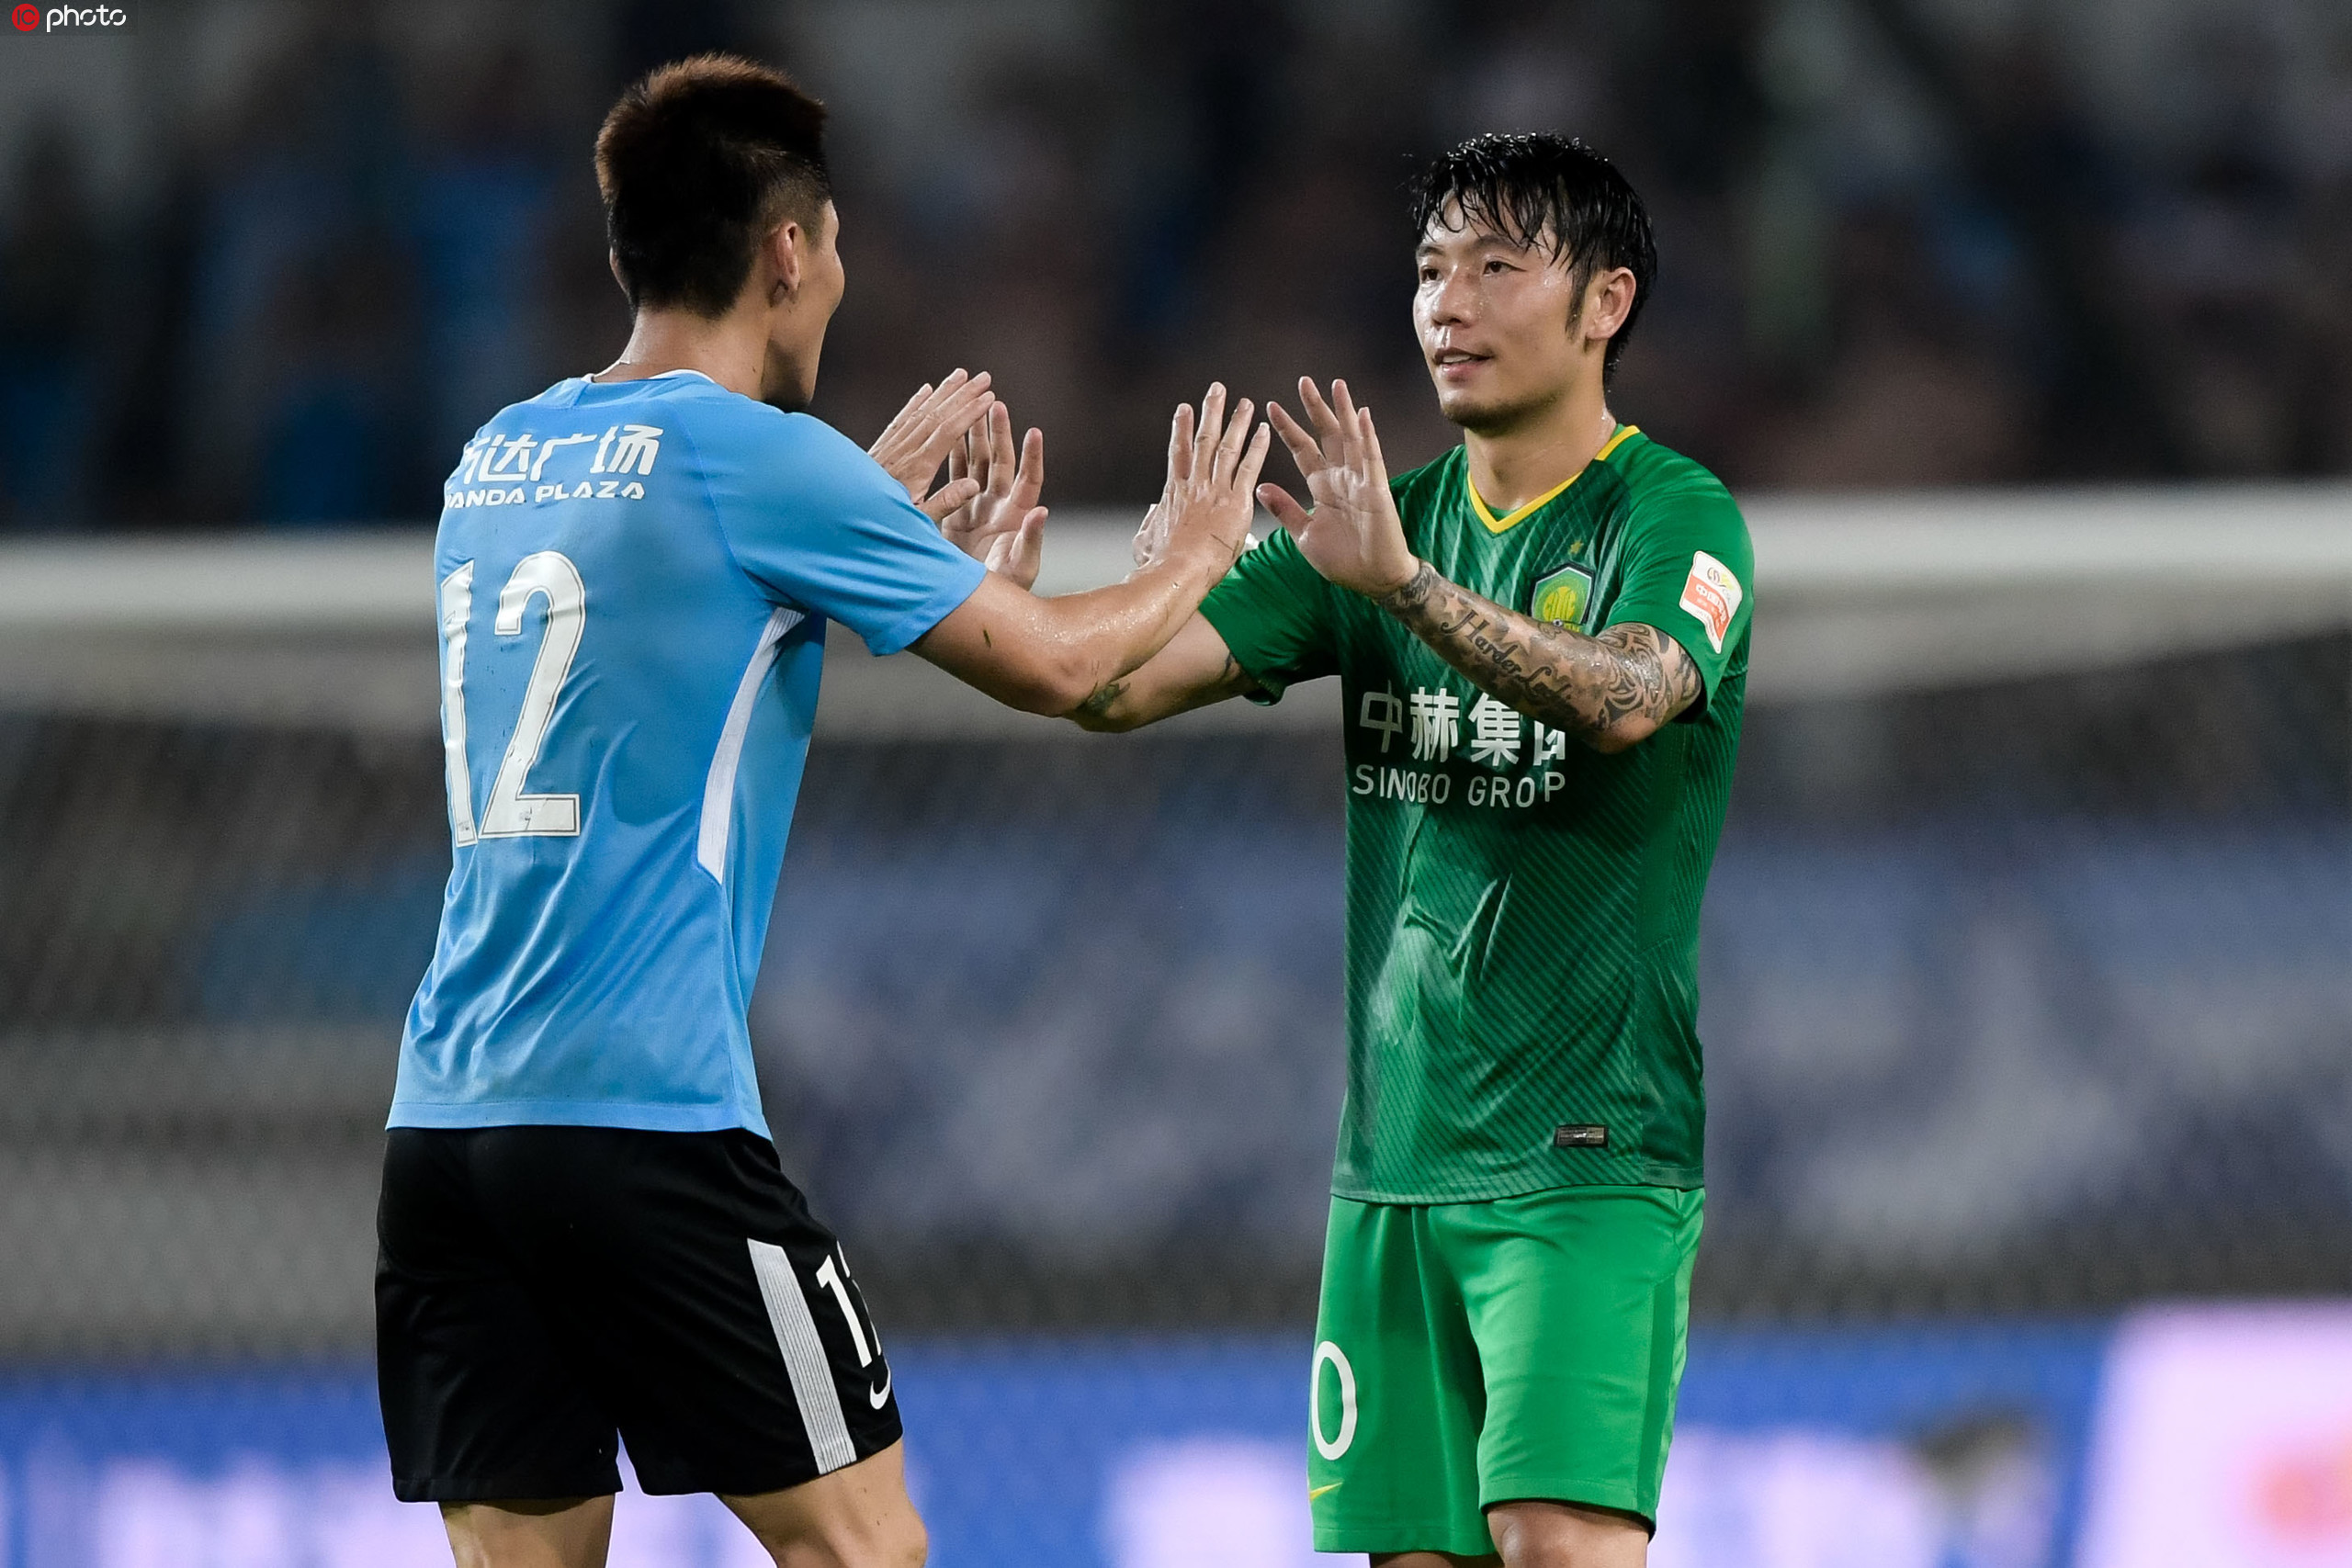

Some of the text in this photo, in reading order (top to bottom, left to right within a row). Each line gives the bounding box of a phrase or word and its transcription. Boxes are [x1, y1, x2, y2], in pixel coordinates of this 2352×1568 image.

[535, 480, 646, 502] PLAZA
[1441, 609, 1522, 675] Harder
[441, 551, 585, 846] 12
[1352, 764, 1451, 805] SINOBO
[816, 1240, 882, 1368] 1
[1311, 1340, 1358, 1461] 0
